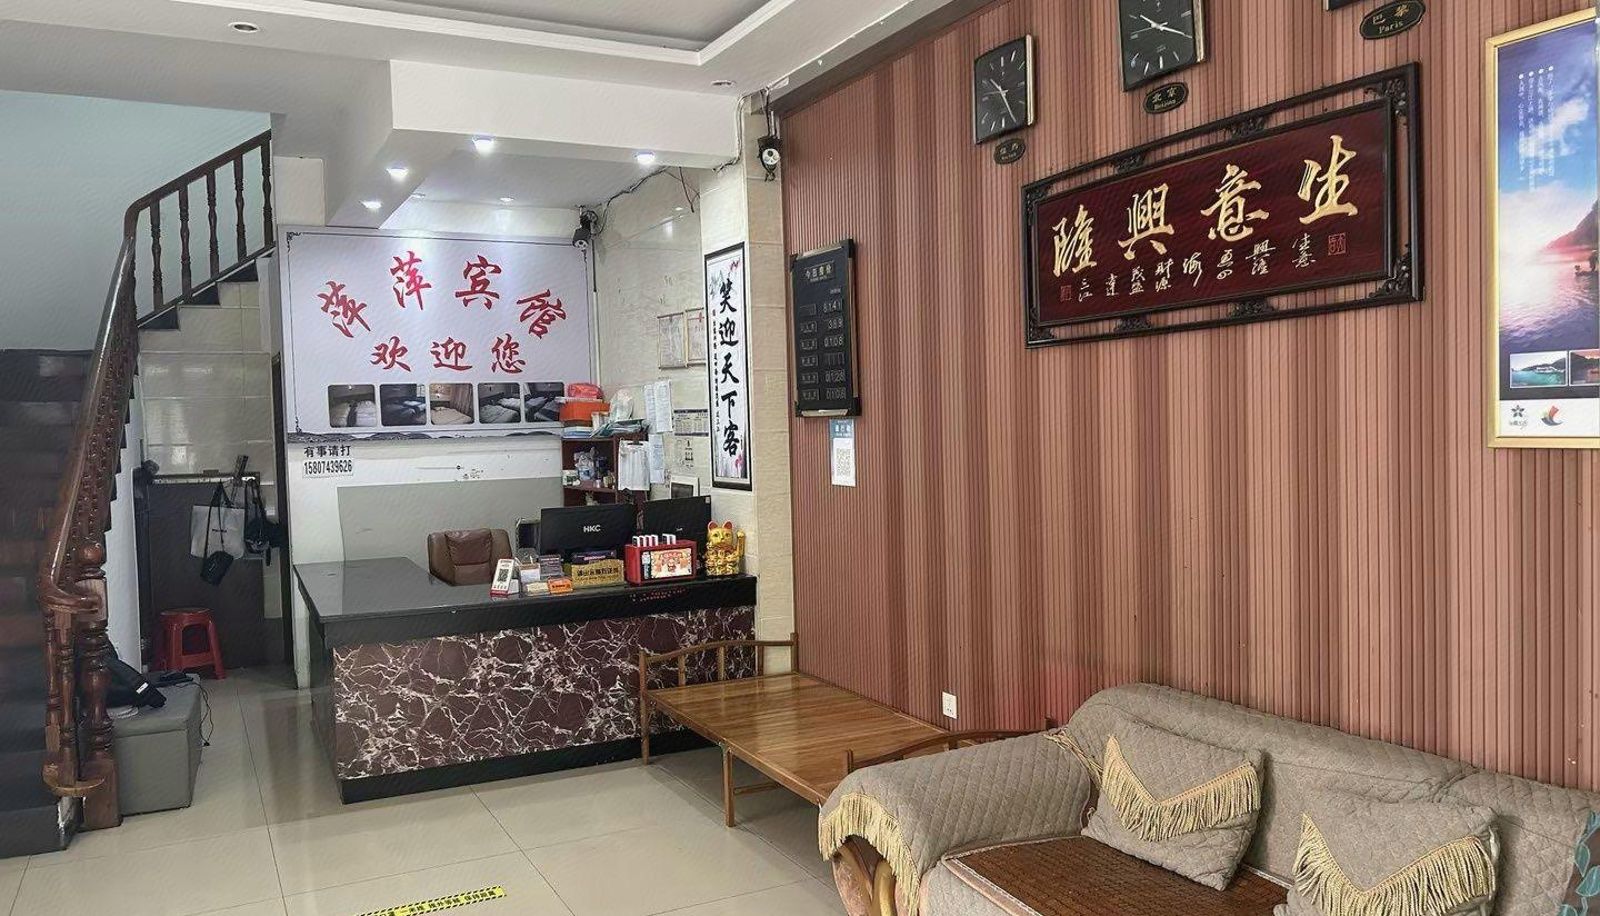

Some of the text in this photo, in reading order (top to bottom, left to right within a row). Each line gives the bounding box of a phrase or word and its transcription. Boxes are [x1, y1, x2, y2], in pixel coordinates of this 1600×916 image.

[1379, 20, 1404, 34] Paris
[370, 333, 527, 374] 欢迎您
[719, 278, 740, 458] 笑迎天下客
[304, 445, 352, 457] 有事请打
[303, 460, 353, 475] 15807439626
[583, 525, 601, 533] HKC
